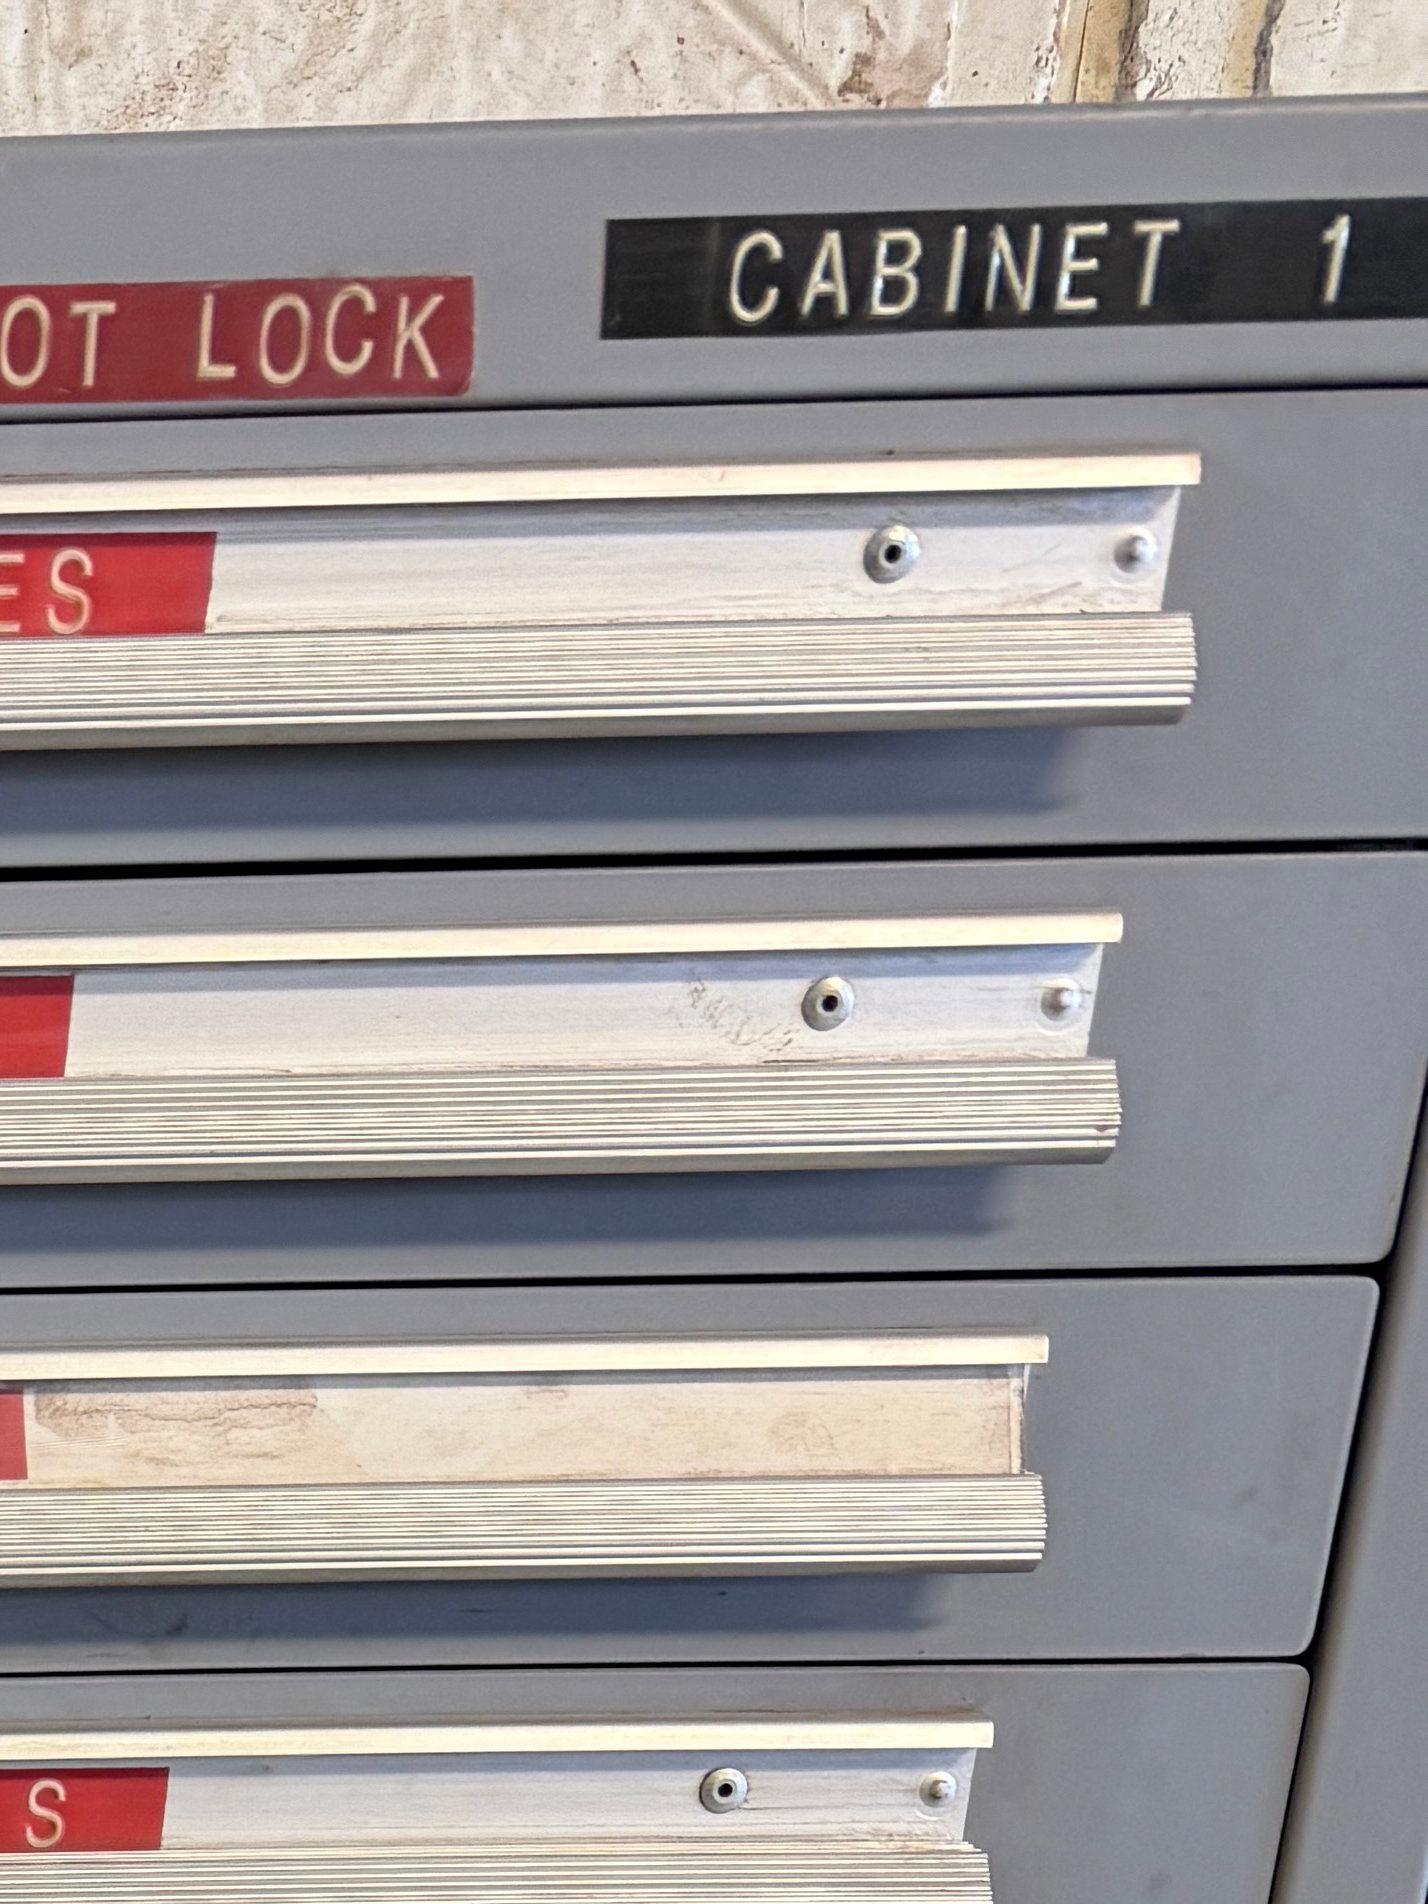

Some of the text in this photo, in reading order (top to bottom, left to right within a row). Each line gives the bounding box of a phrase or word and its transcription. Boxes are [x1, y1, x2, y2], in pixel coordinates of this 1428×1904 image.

[727, 214, 1352, 324] CABINET 1
[196, 285, 448, 388] LOCK
